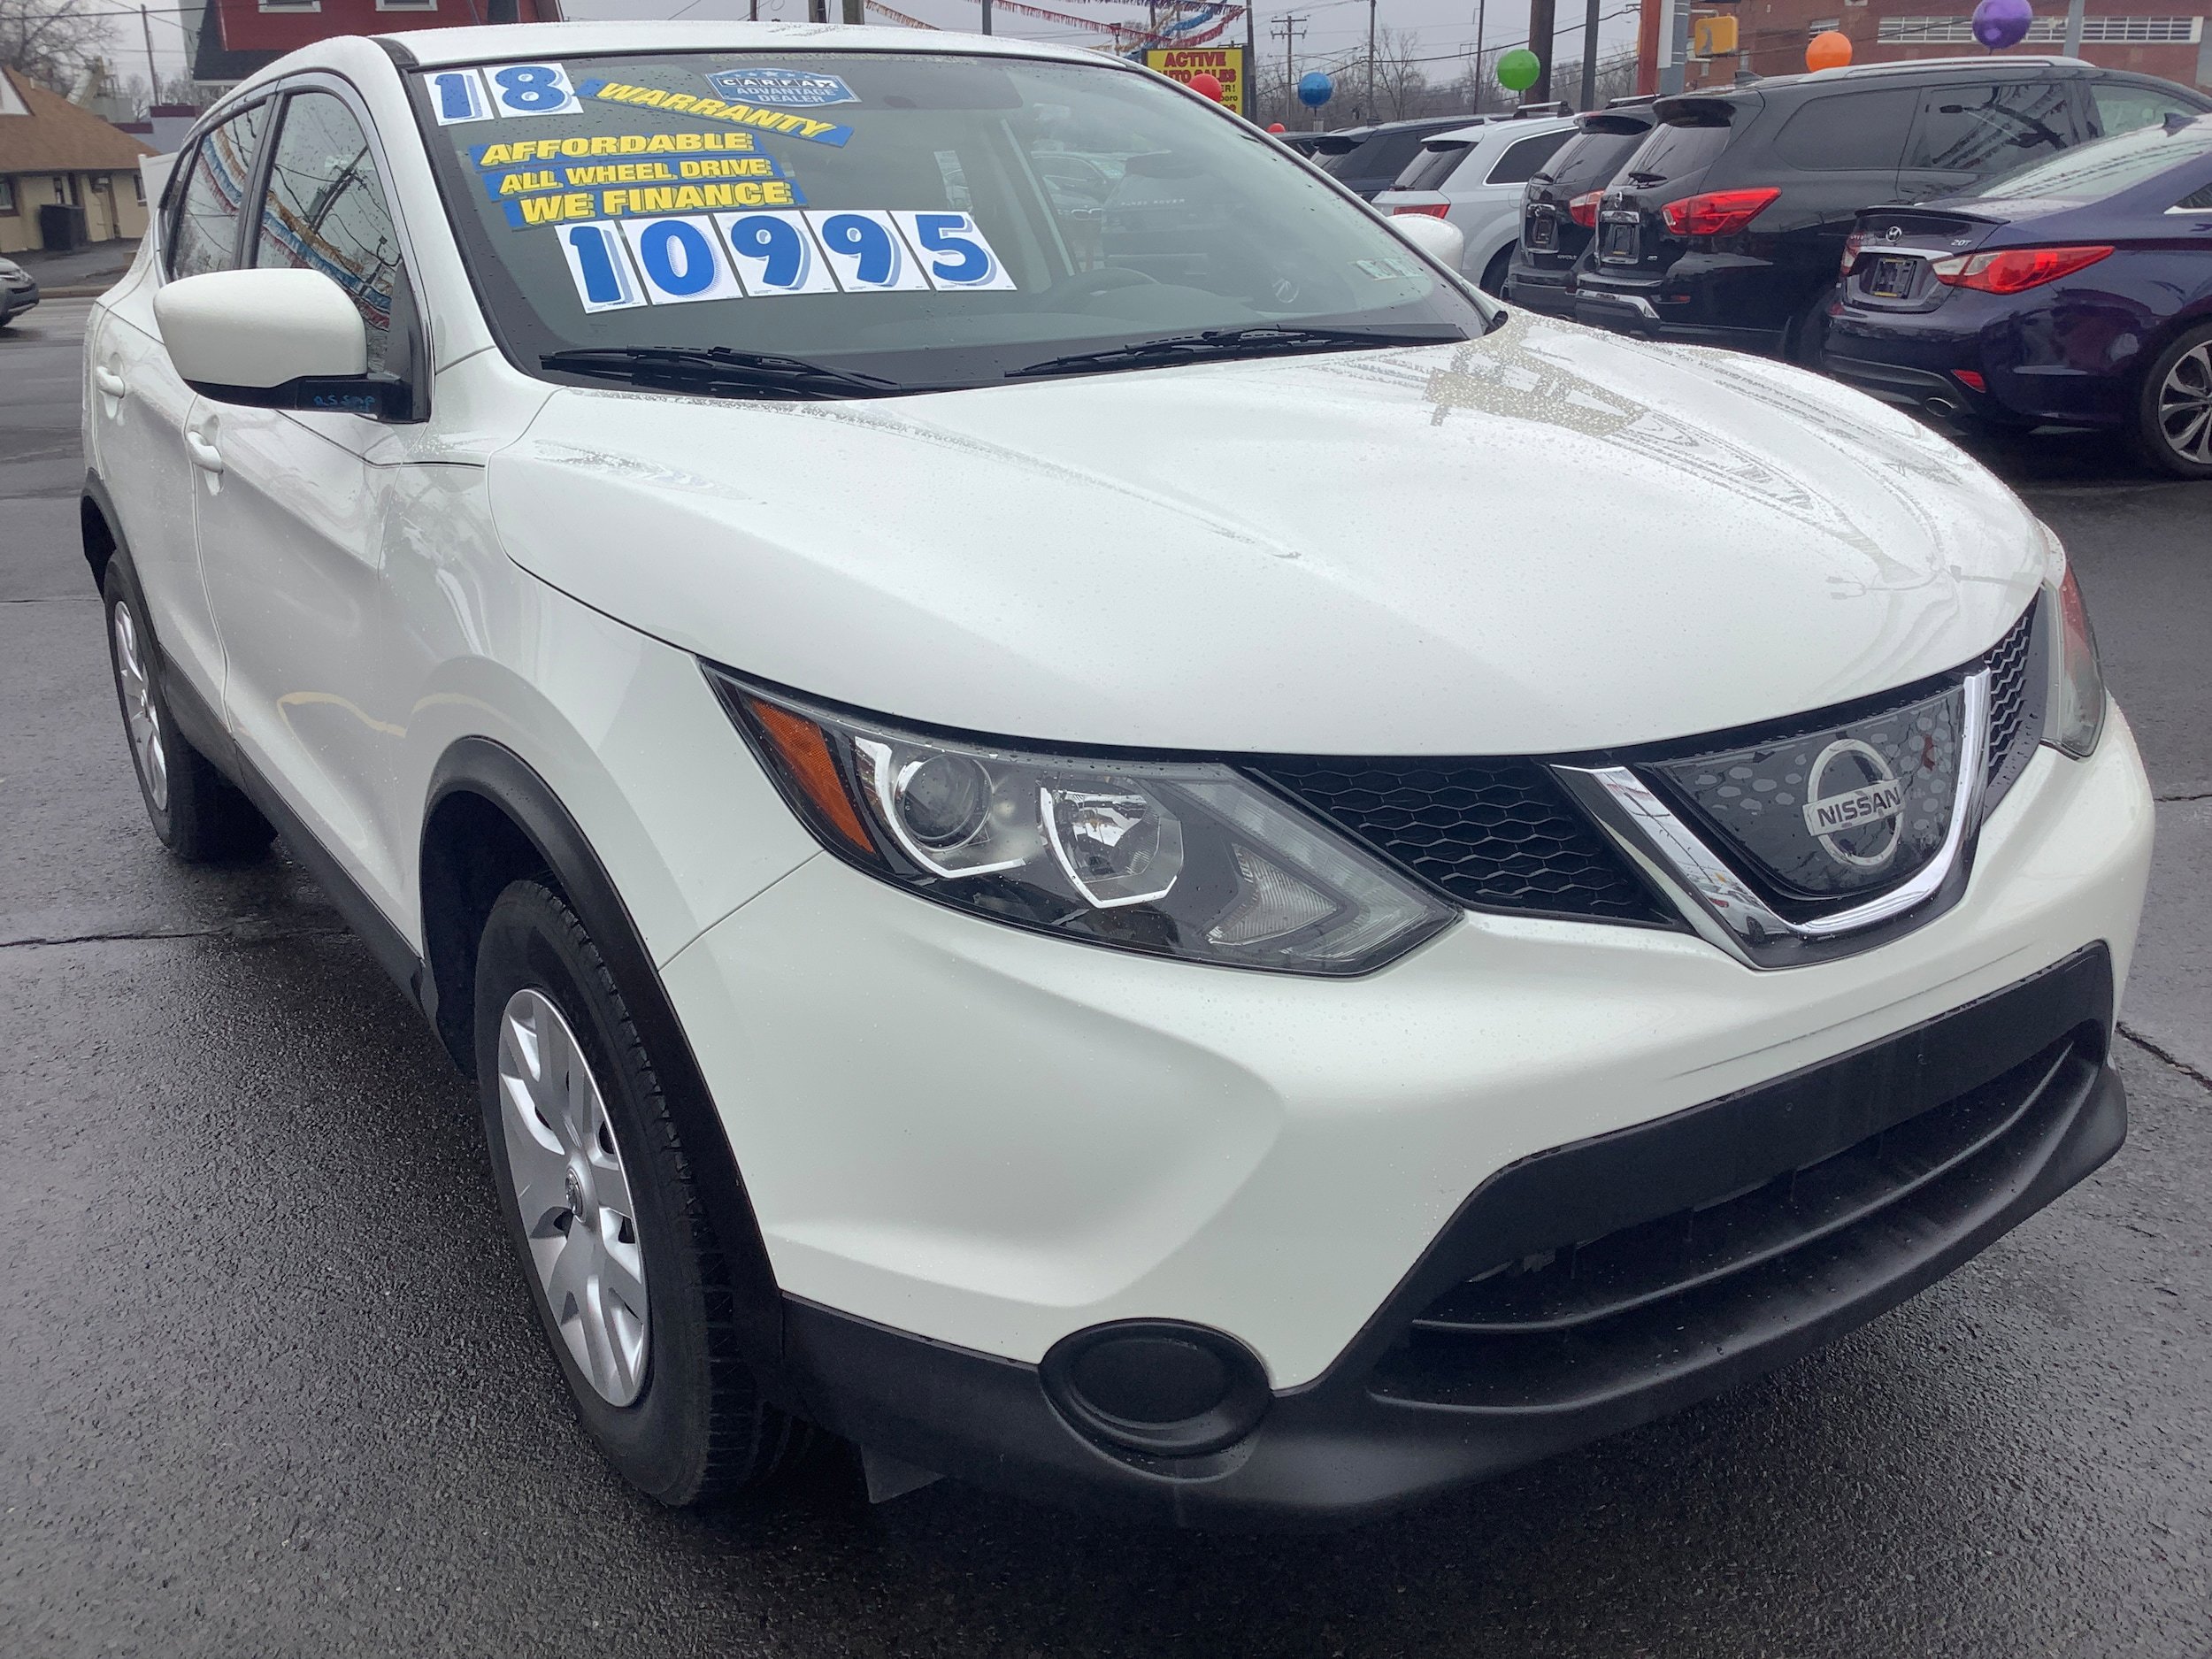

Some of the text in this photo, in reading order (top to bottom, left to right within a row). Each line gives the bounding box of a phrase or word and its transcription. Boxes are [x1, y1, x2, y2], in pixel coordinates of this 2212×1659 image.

[1164, 51, 1226, 67] ACTIVE
[434, 65, 564, 119] 18
[722, 78, 836, 89] CARFAX
[736, 87, 835, 96] ADVANTAGE
[1156, 70, 1192, 84] UTO
[596, 82, 836, 138] WARRANTY
[757, 94, 826, 104] DEALER
[480, 133, 755, 166] AFFORDABLE
[499, 158, 773, 195] ALL WHEEL DRIVE
[519, 181, 795, 226] WE FINANCE
[569, 214, 995, 303] 10995
[1816, 787, 1901, 827] NISSAN
